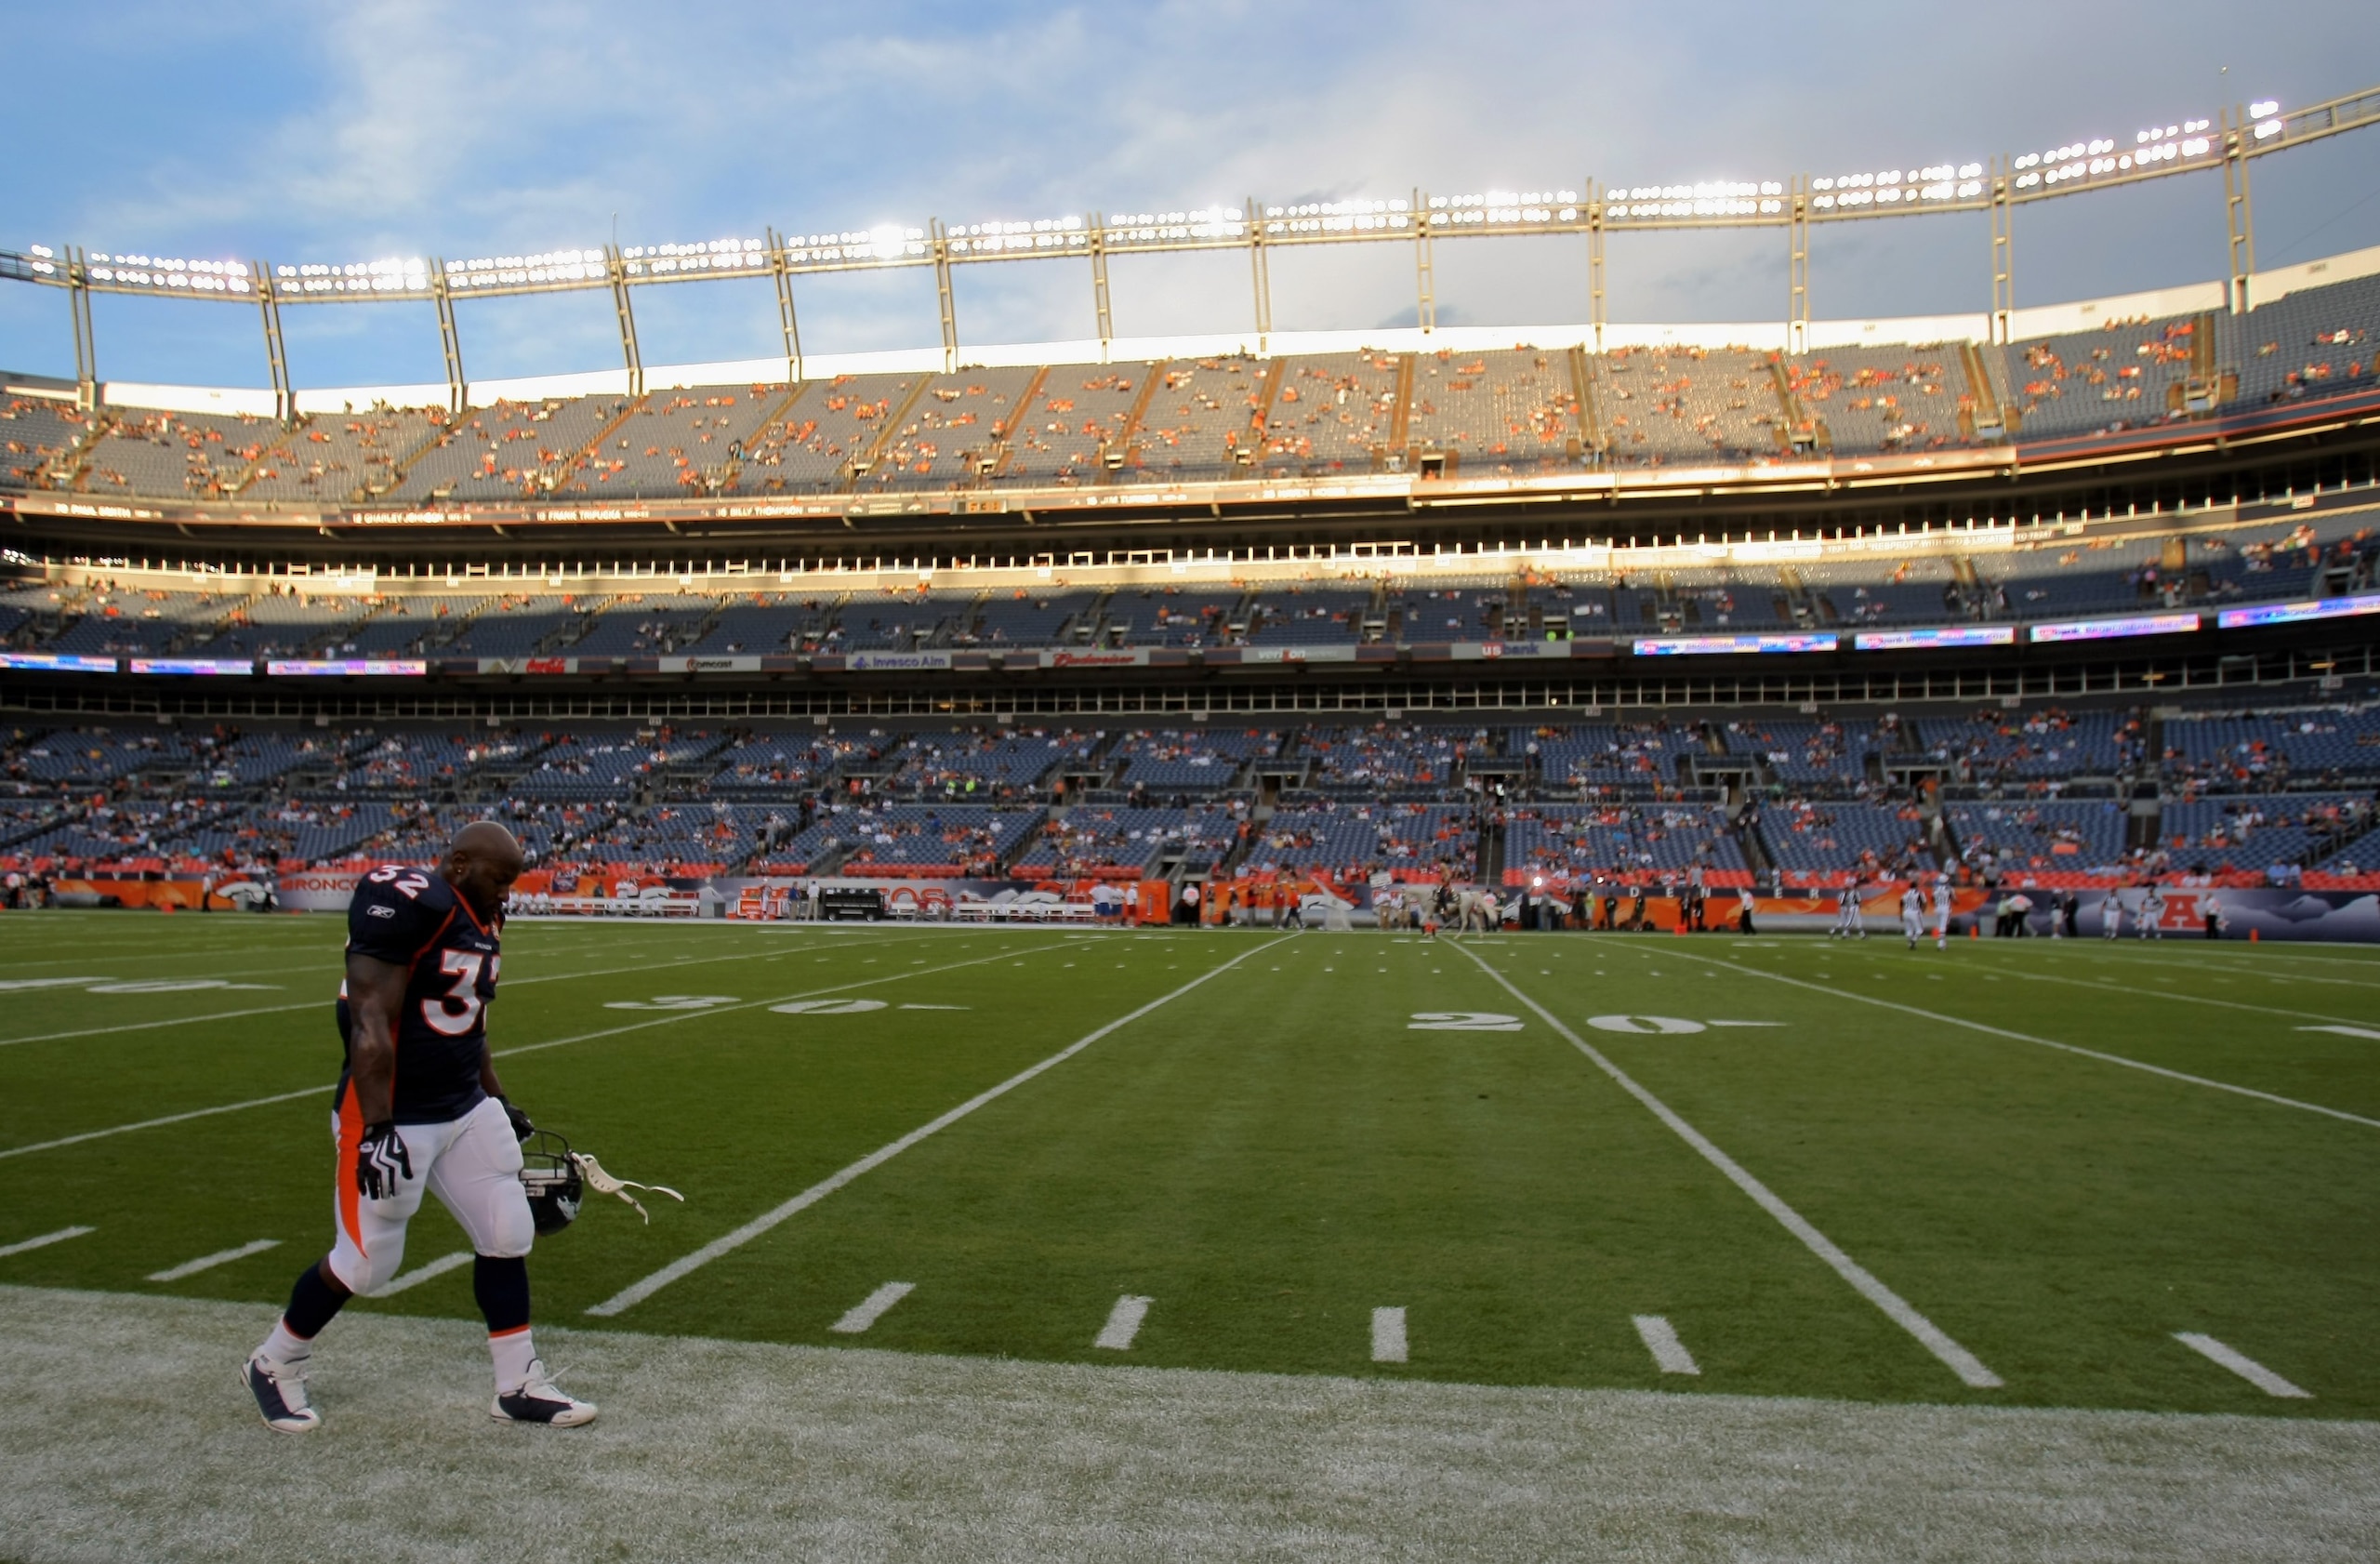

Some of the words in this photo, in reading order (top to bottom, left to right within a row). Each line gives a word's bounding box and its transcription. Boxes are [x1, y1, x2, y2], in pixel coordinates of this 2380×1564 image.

[549, 510, 577, 522] FRANK
[730, 506, 752, 517] BILLY
[754, 505, 803, 516] THOMPSON
[1258, 646, 1305, 660] verizon
[873, 656, 920, 669] Invesco
[921, 656, 945, 668] Aim
[1052, 653, 1135, 667] Budweiser
[281, 878, 361, 891] BRONCO
[369, 865, 430, 899] 32
[421, 948, 500, 1036] 3
